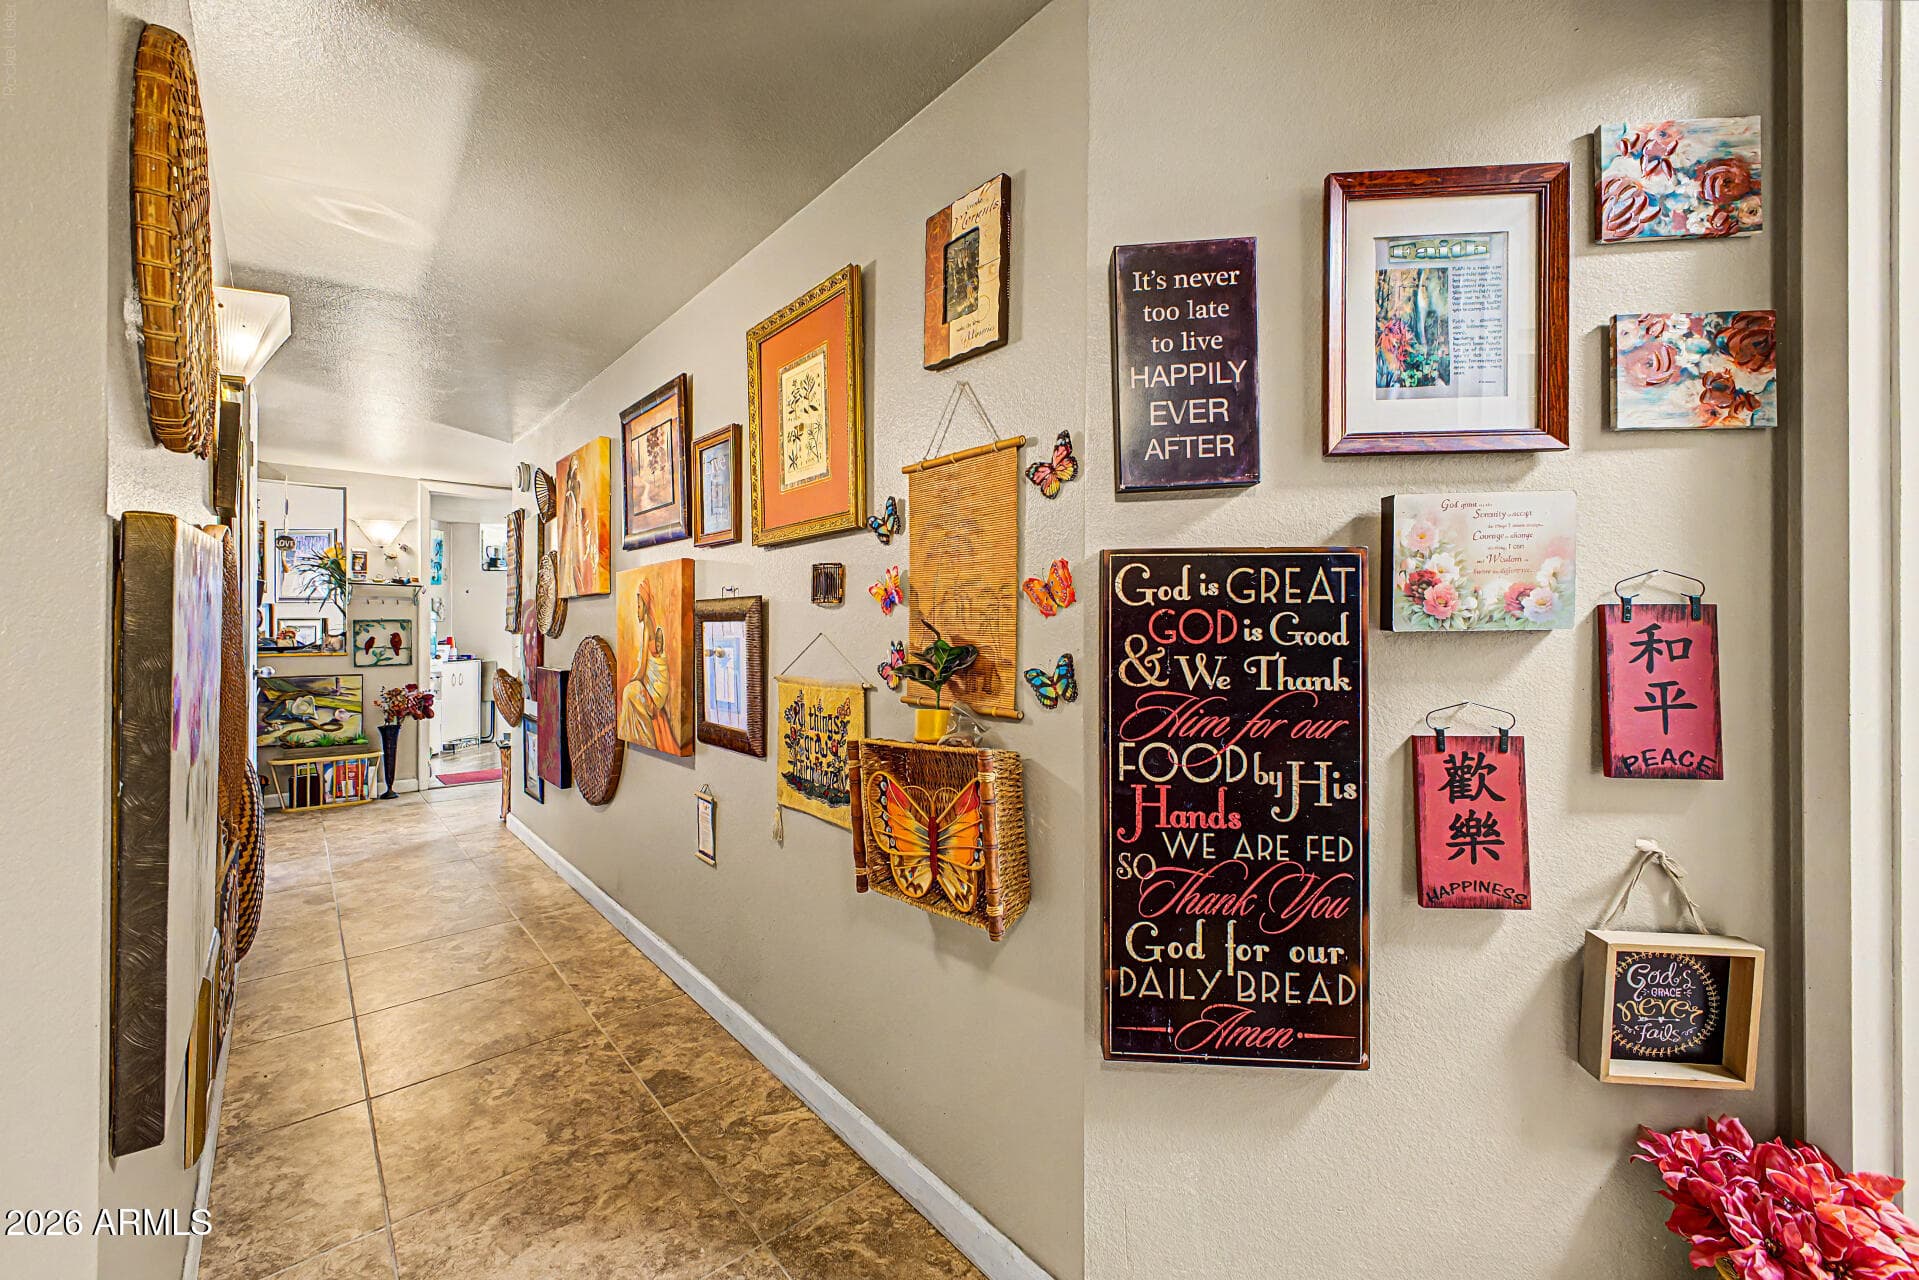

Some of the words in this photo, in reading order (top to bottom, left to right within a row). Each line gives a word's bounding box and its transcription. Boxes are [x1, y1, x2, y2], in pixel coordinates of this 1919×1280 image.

[1391, 239, 1488, 259] Faith
[1132, 270, 1167, 292] It's
[1173, 269, 1240, 289] never
[1143, 304, 1180, 322] too
[1186, 299, 1230, 320] late
[1150, 336, 1174, 353] to
[1180, 331, 1224, 352] live
[1130, 359, 1248, 389] HAPPILY
[1149, 398, 1230, 426] EVER
[1144, 434, 1235, 461] AFTER
[1115, 563, 1191, 606] God
[1200, 573, 1219, 596] is
[1226, 566, 1356, 604] GREAT
[1148, 608, 1238, 645] GOD
[1243, 618, 1263, 641] is
[1270, 611, 1349, 646] Good
[1118, 634, 1169, 688] &
[1174, 653, 1231, 691] We
[1244, 652, 1352, 691] Thank
[1628, 623, 1697, 736] 和平
[808, 704, 840, 741] things
[1119, 690, 1231, 742] Him
[1290, 720, 1349, 739] our
[1621, 748, 1717, 776] PEACE
[1118, 742, 1248, 783] FOOD
[1253, 752, 1283, 798] by
[1271, 761, 1358, 823] His
[1117, 784, 1242, 843] Hands
[1162, 831, 1216, 860] WE
[1233, 834, 1290, 861] ARE
[1306, 835, 1354, 863] FED
[1139, 859, 1298, 918] Thank
[1259, 872, 1355, 935] You
[1426, 880, 1528, 905] HAPPINESS
[1126, 918, 1206, 963] God
[1225, 919, 1270, 977] for
[1289, 945, 1344, 964] our
[1119, 966, 1222, 1000] DAILY
[1237, 970, 1356, 1006] BREAD
[1627, 962, 1697, 1001] God's
[1651, 988, 1682, 997] GRACE
[1175, 1003, 1295, 1052] Amen
[1617, 998, 1704, 1025] never
